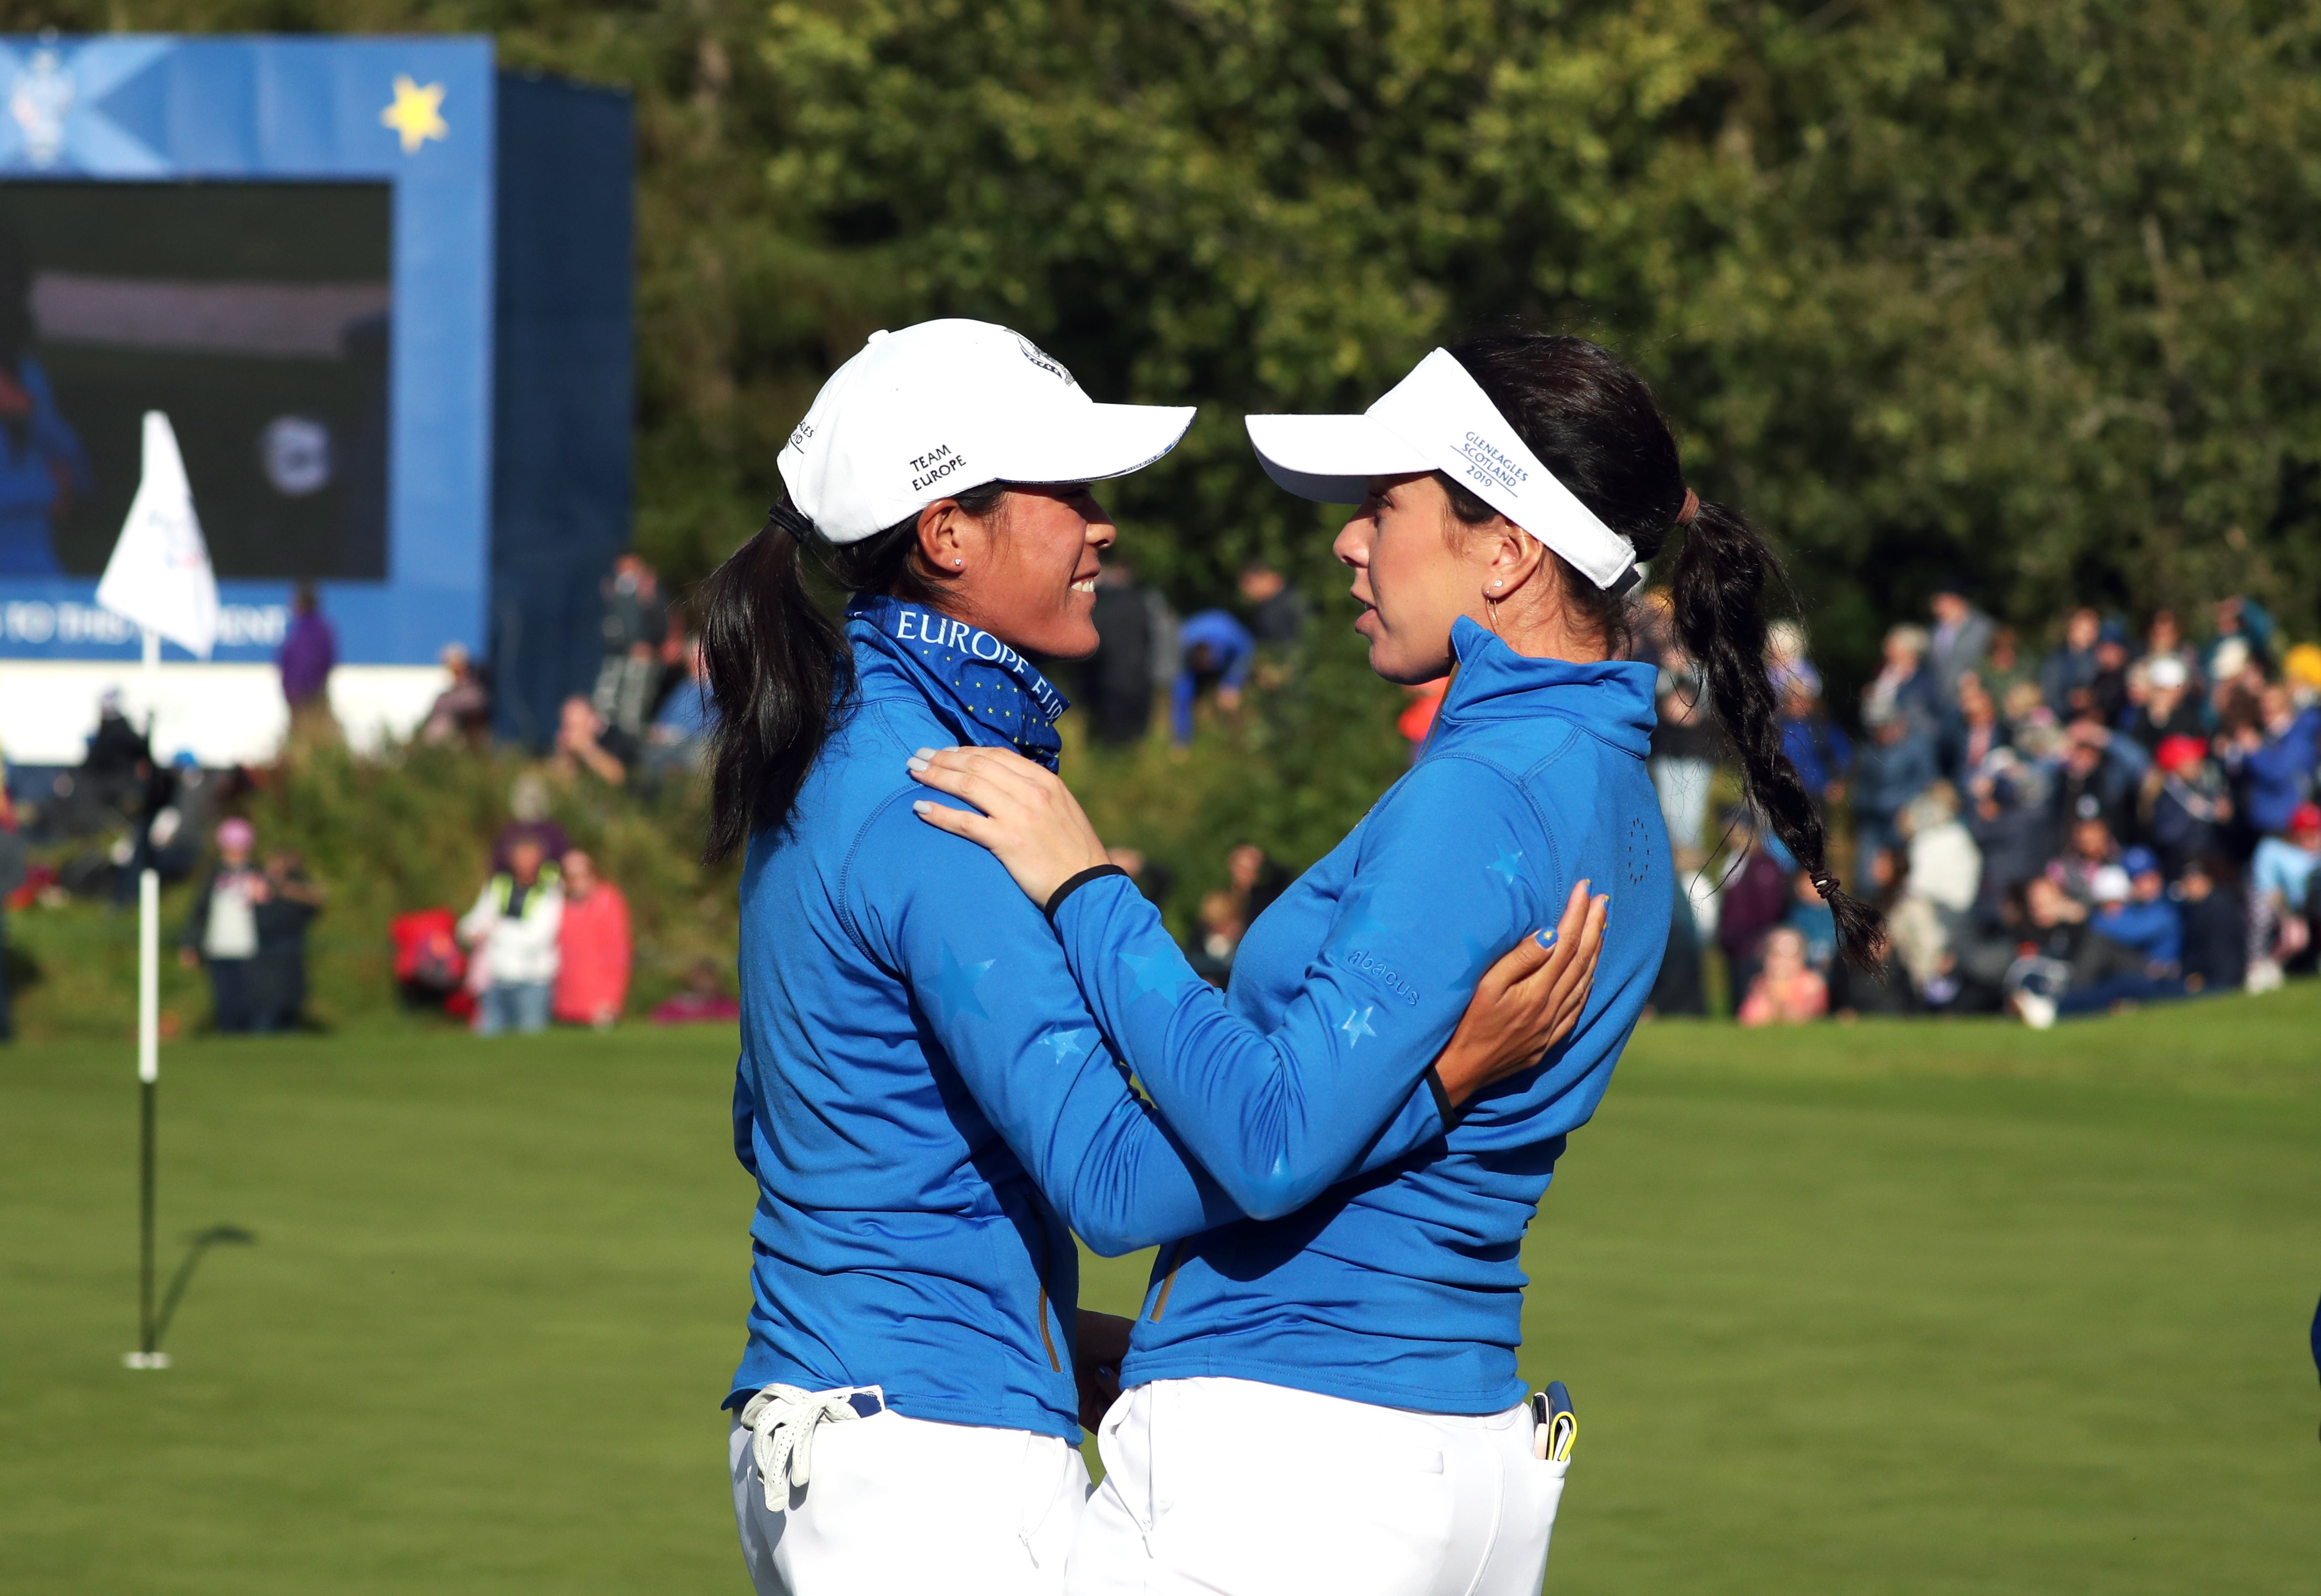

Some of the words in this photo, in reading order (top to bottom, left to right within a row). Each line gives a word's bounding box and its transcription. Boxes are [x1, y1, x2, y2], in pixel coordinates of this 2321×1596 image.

[909, 444, 952, 472] TEAM
[912, 455, 966, 491] EUROPE
[1462, 443, 1517, 487] SCOTLAND
[1465, 431, 1529, 482] GLENEAGLES
[1465, 465, 1493, 487] 2019
[1347, 950, 1420, 1006] abacus
